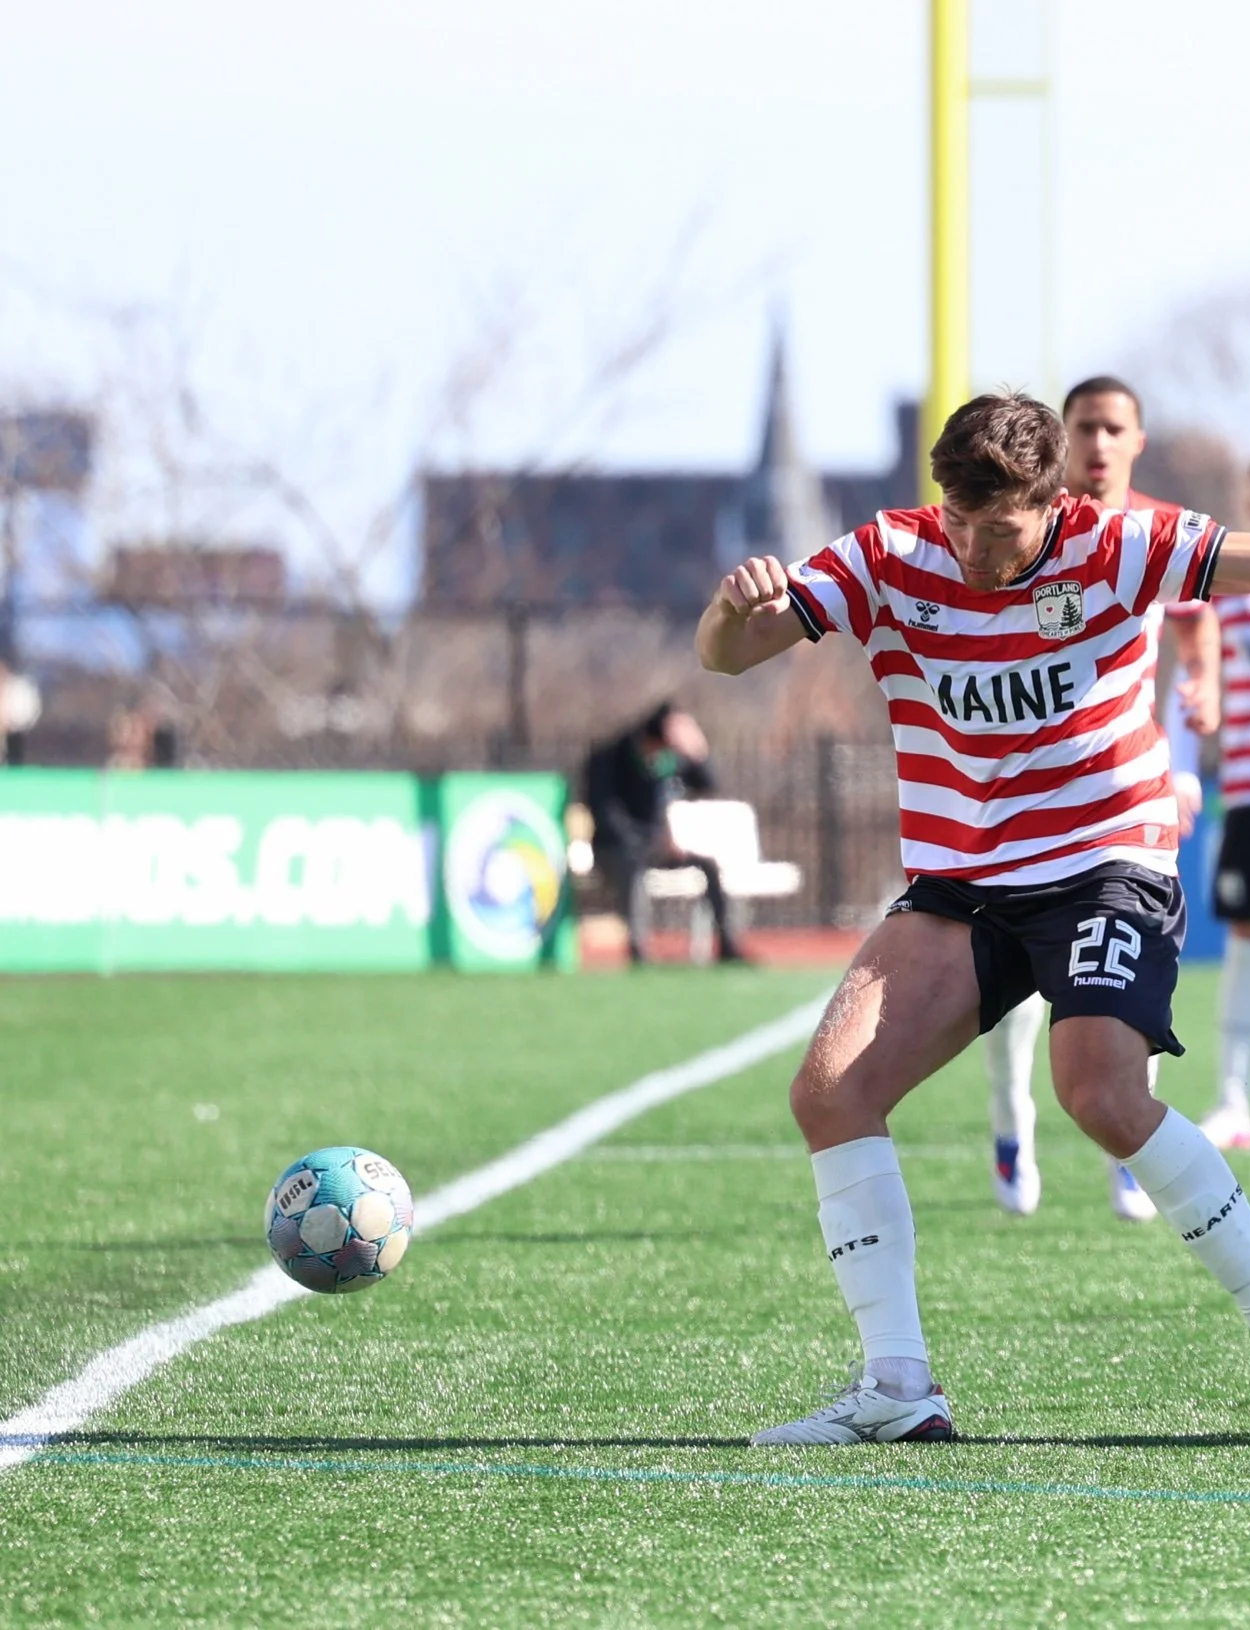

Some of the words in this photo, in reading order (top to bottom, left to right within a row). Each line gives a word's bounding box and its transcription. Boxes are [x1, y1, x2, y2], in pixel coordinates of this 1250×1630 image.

[1035, 583, 1080, 601] PORTLAND
[908, 618, 939, 632] hummel
[1068, 916, 1142, 982] 22
[1073, 976, 1126, 991] hummel
[1181, 1183, 1243, 1242] HEARTS
